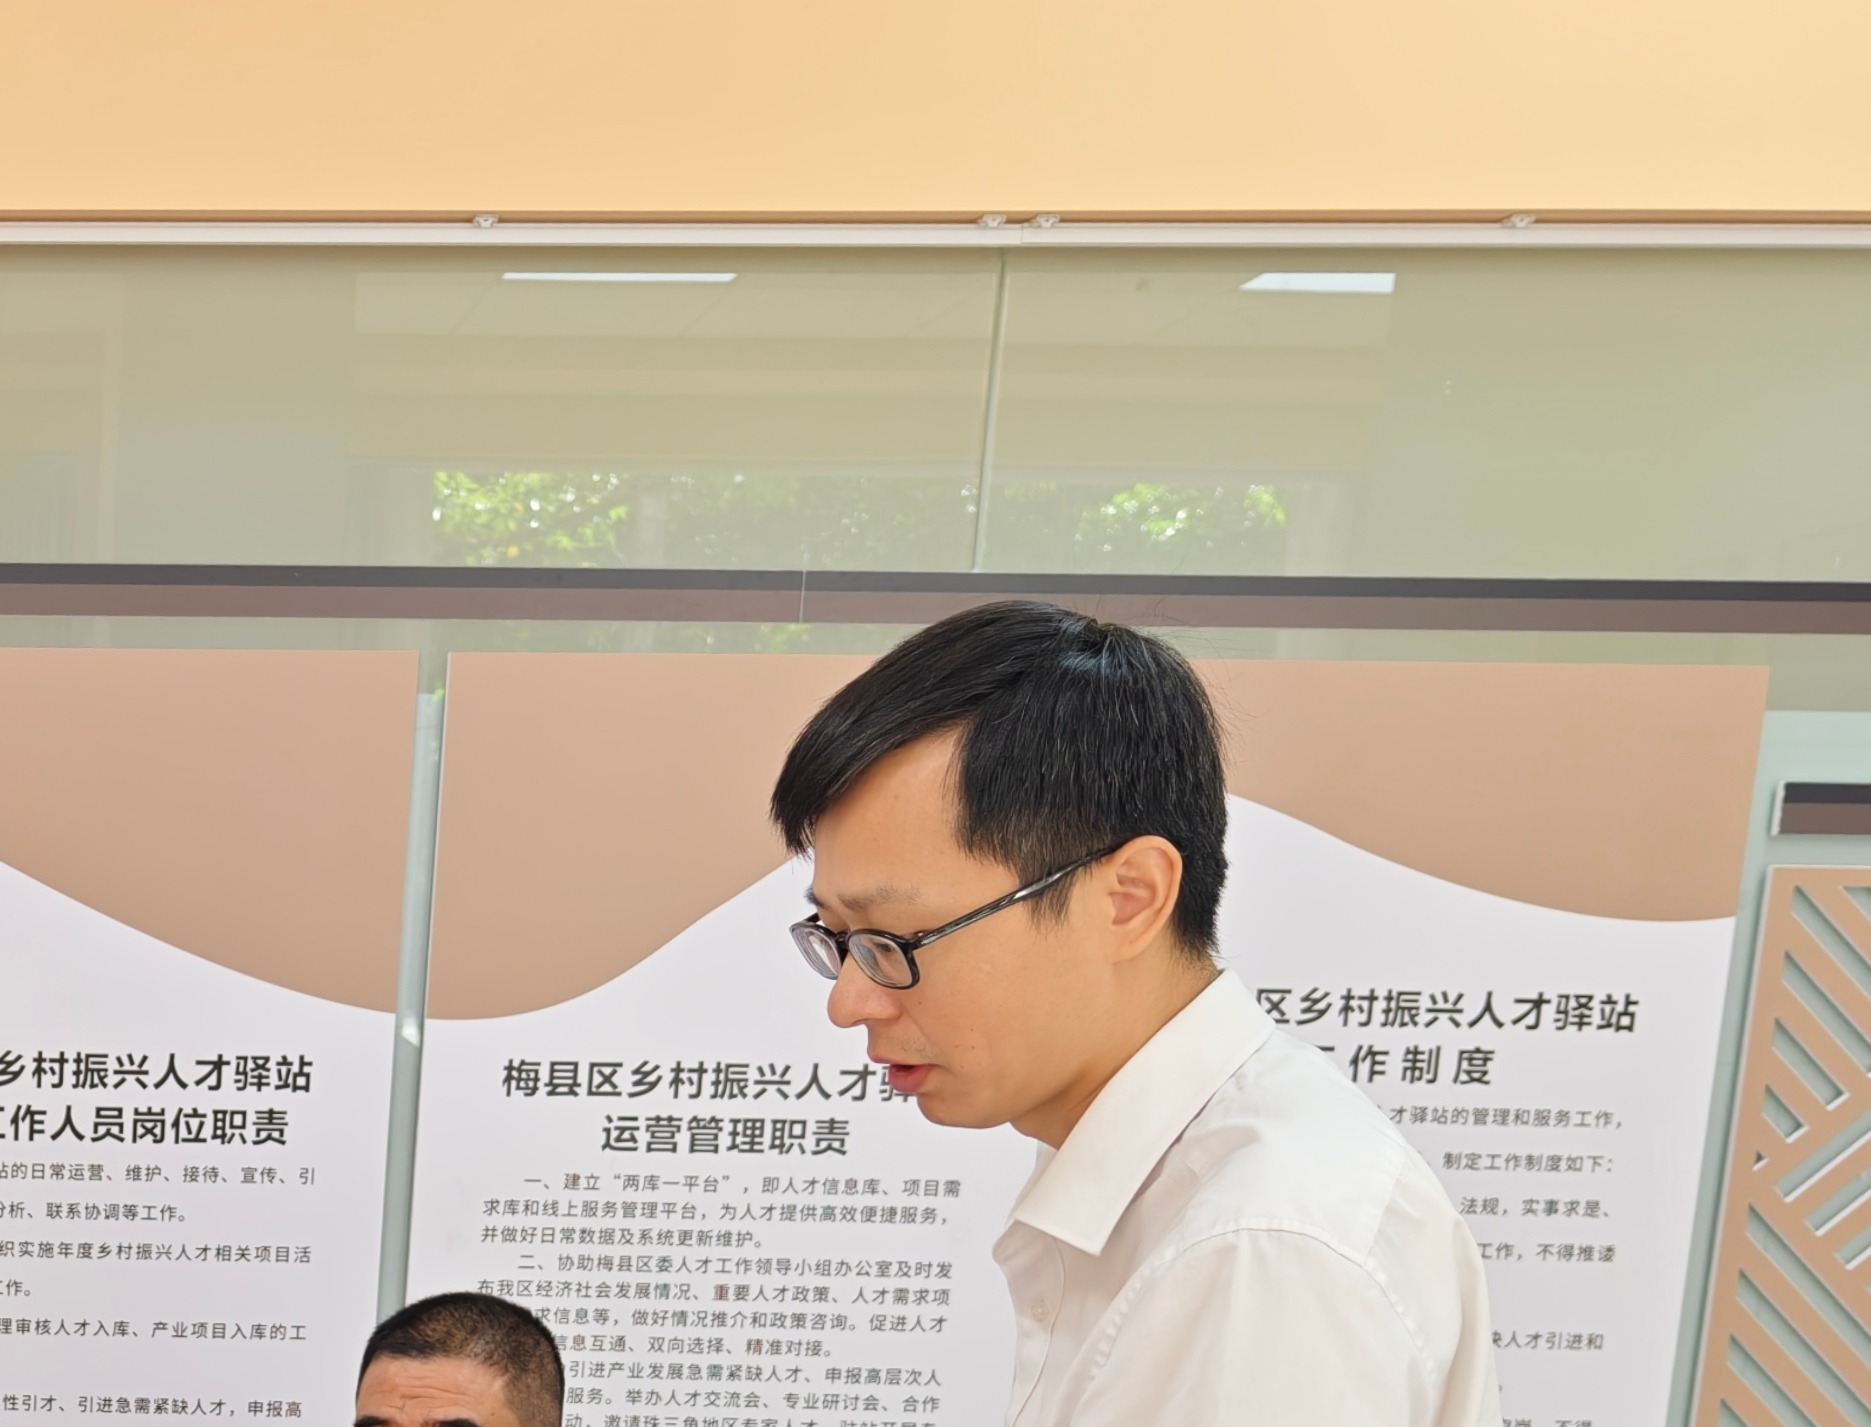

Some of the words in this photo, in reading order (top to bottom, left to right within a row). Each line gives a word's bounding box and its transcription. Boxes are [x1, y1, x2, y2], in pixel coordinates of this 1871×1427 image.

[1256, 987, 1640, 1033] 区乡村振兴人才驿站
[1318, 1044, 1495, 1086] 作制度
[601, 1114, 850, 1156] 运营管理职责
[483, 1198, 946, 1224] 求库和线上服务管理平台，为人才提供高效便捷服务，
[481, 1225, 761, 1248] 并做好日常数据及系统更新维护。
[518, 1254, 952, 1279] 二、协助梅县区委人才工作领导小组办公室及时发
